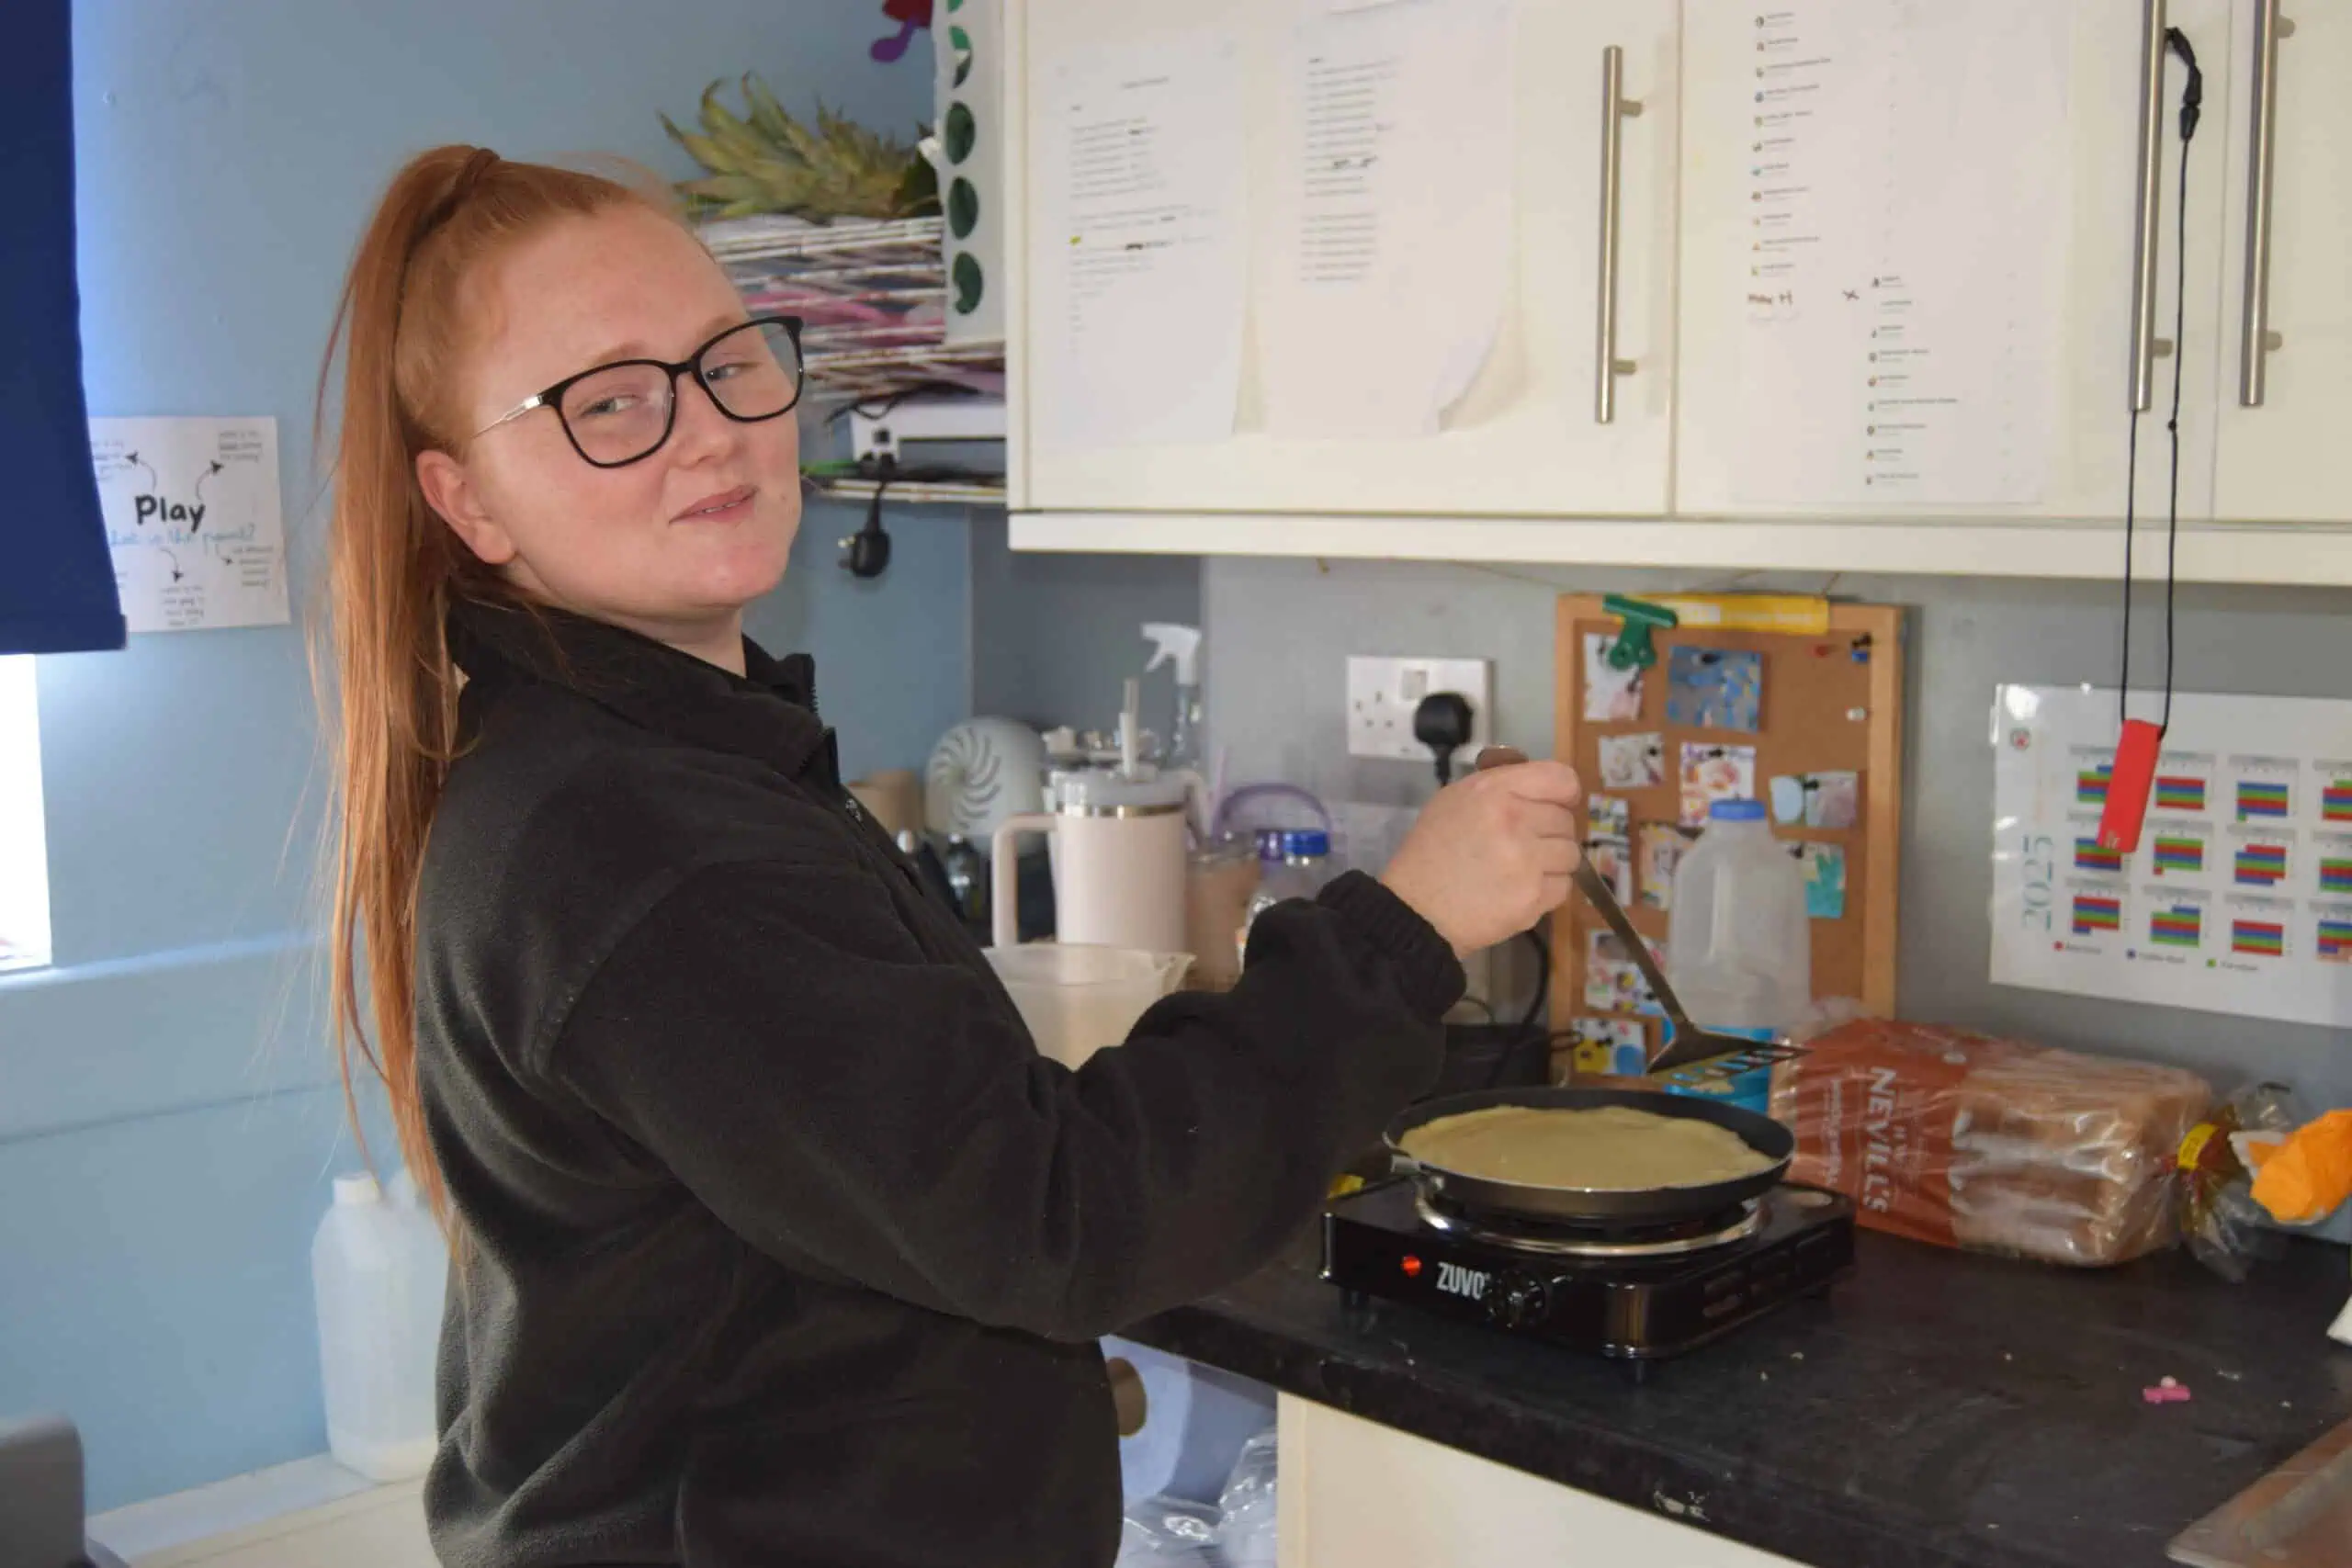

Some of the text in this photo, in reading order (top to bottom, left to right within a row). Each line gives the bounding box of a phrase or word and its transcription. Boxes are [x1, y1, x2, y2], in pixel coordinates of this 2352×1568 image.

[134, 493, 207, 534] Play
[2021, 833, 2054, 932] 2025
[1436, 1259, 1486, 1301] ZUVO
